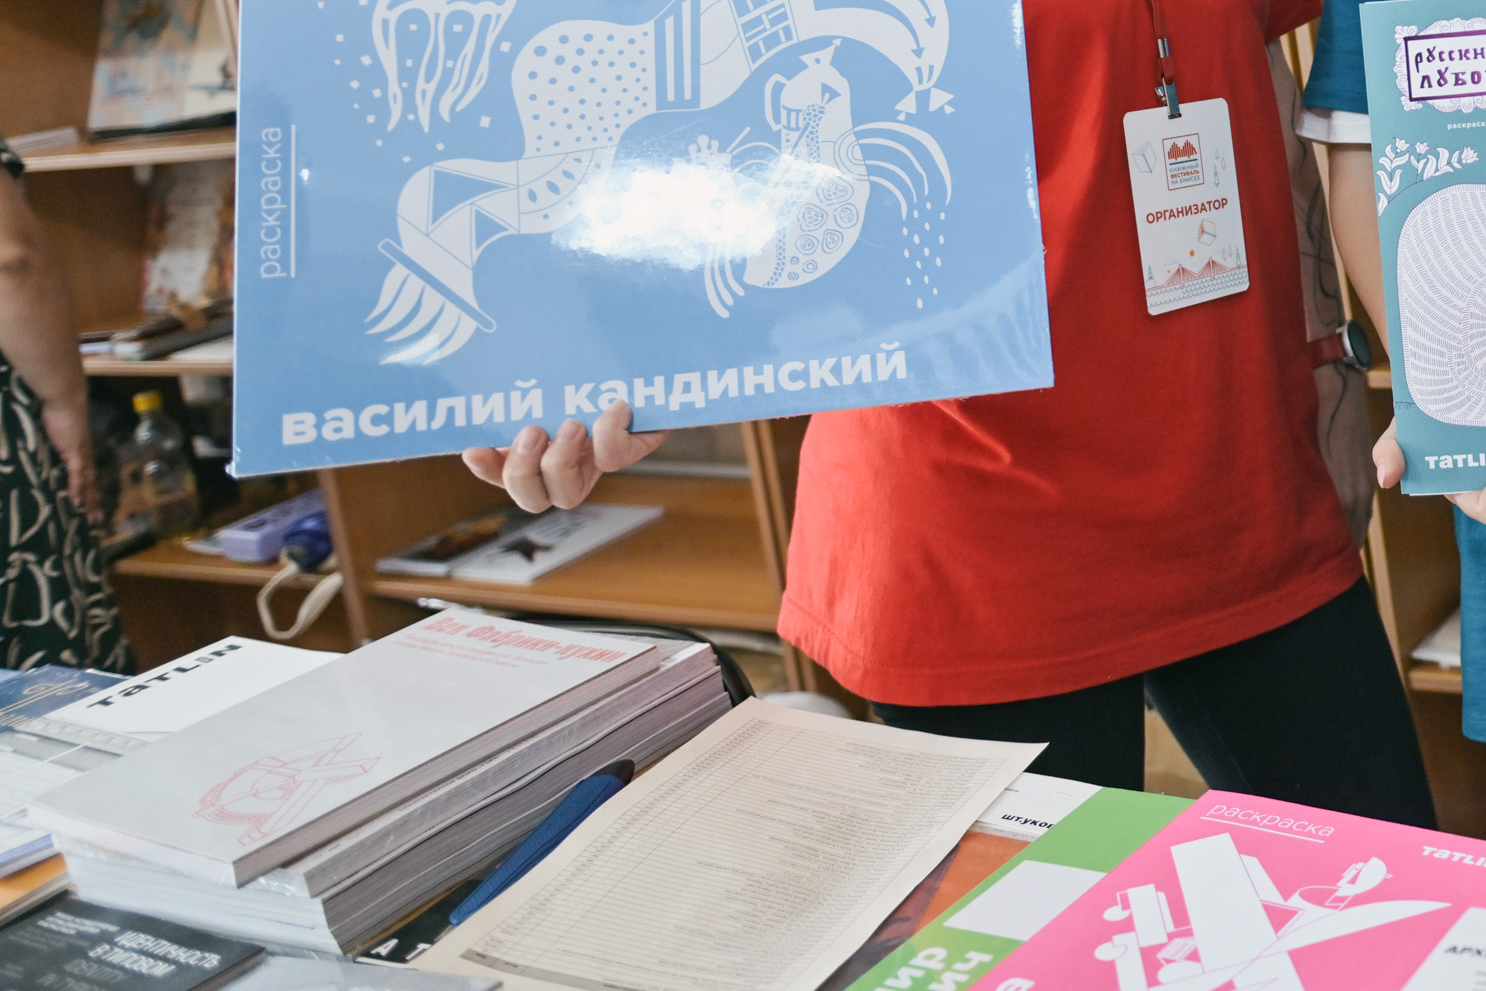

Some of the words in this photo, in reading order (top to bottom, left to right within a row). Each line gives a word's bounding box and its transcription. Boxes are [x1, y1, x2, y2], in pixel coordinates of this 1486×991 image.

[1169, 162, 1200, 173] КНИЖНЫЙ
[1170, 169, 1200, 179] ФЕСТИВАЛЬ
[1180, 175, 1201, 184] ЕНИСЕЕ
[260, 126, 287, 279] раскраска
[1145, 197, 1229, 224] ОРГАНИЗАТОР
[282, 377, 543, 446] василий
[563, 340, 908, 417] кандинский
[423, 616, 472, 635] Век
[465, 623, 628, 664] Фабрики-кухни
[1206, 799, 1336, 841] раскраска
[87, 941, 111, 958] В
[101, 945, 177, 977] ТИПОВОМ
[113, 930, 222, 969] ИДЕНТИЧНОСТЬ
